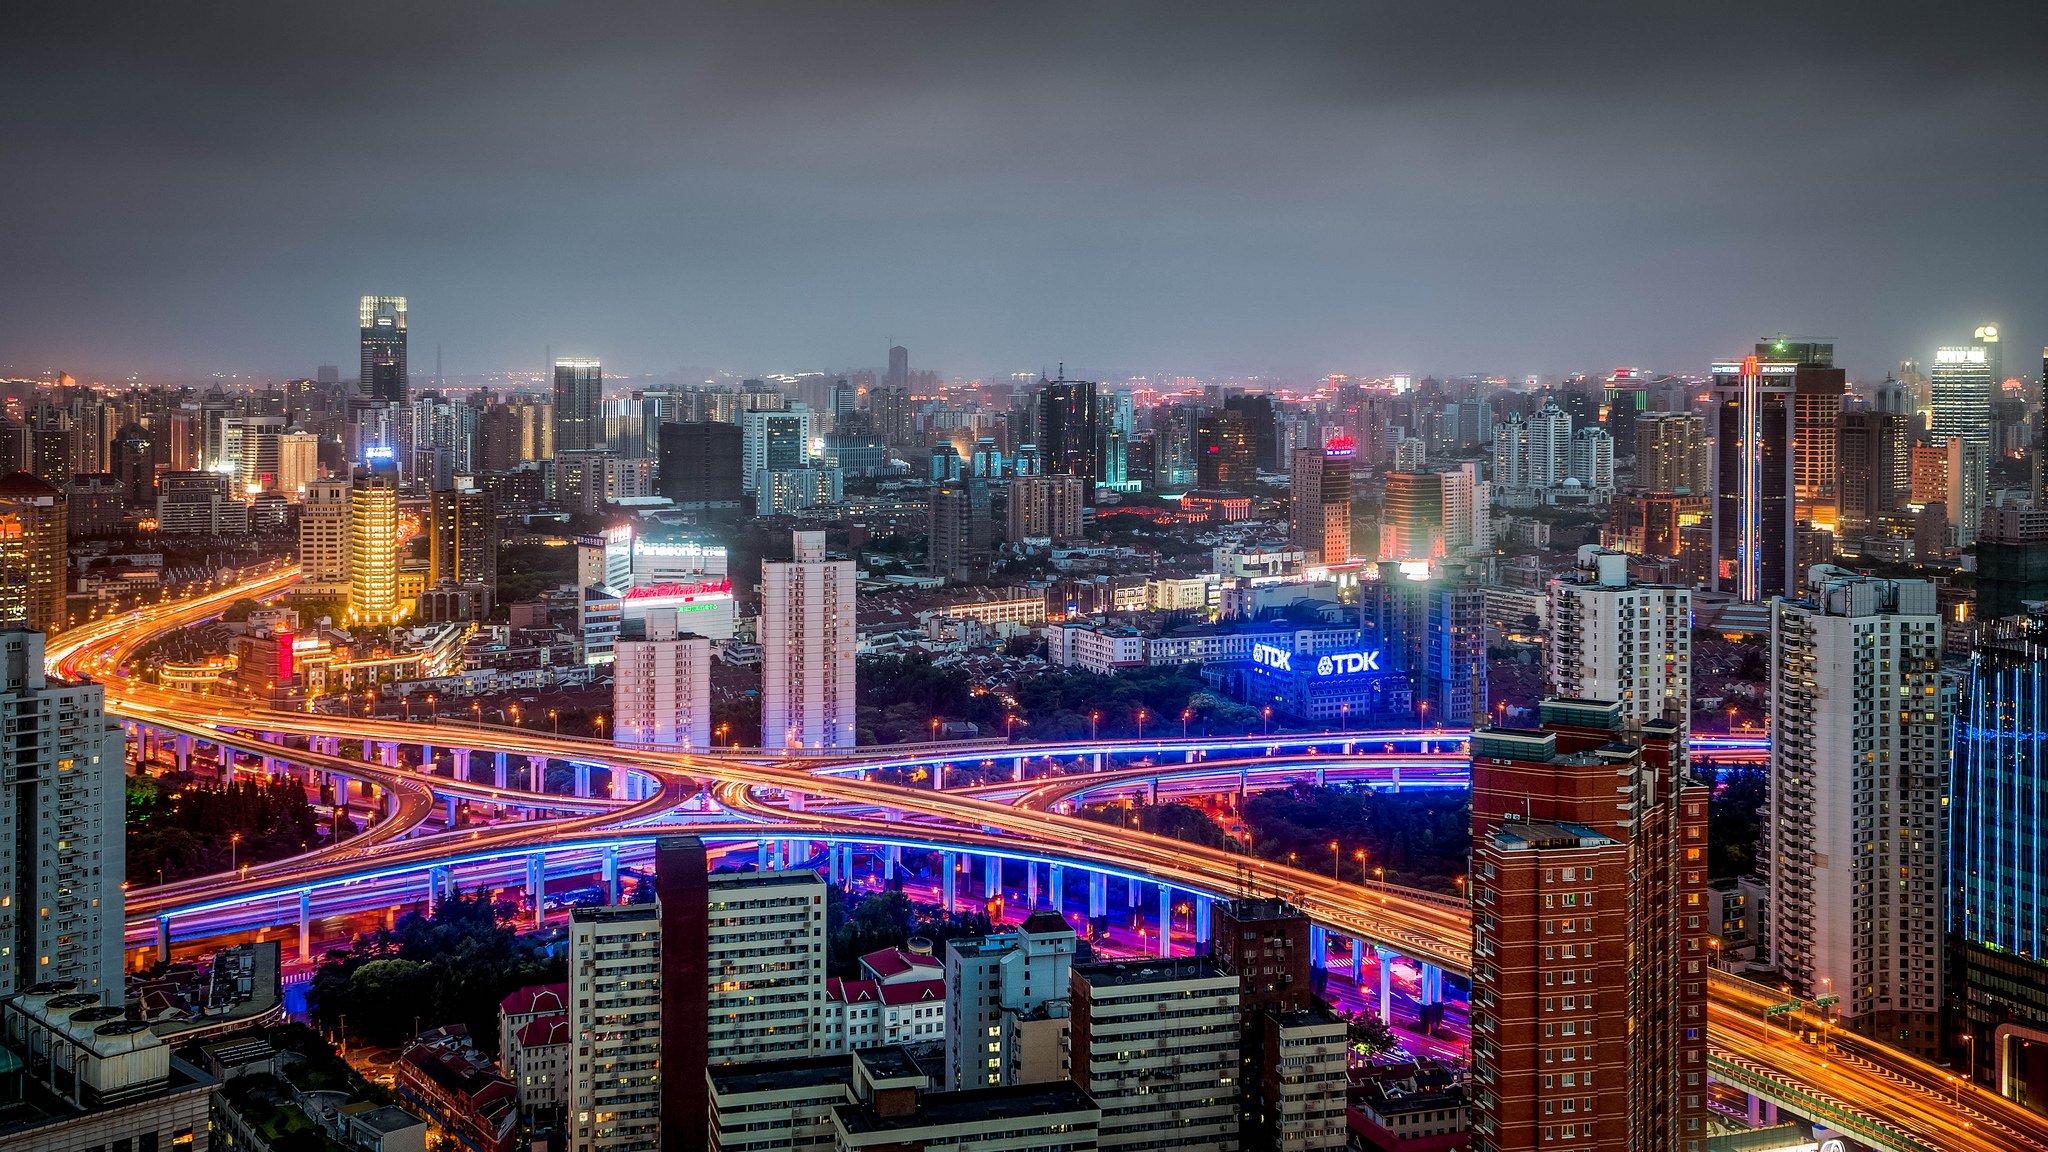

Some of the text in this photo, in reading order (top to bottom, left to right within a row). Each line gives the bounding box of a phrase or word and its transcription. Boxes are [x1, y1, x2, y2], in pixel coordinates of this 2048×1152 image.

[634, 540, 701, 556] Panasonic
[1261, 644, 1291, 671] TDK
[1331, 651, 1379, 674] TDK
